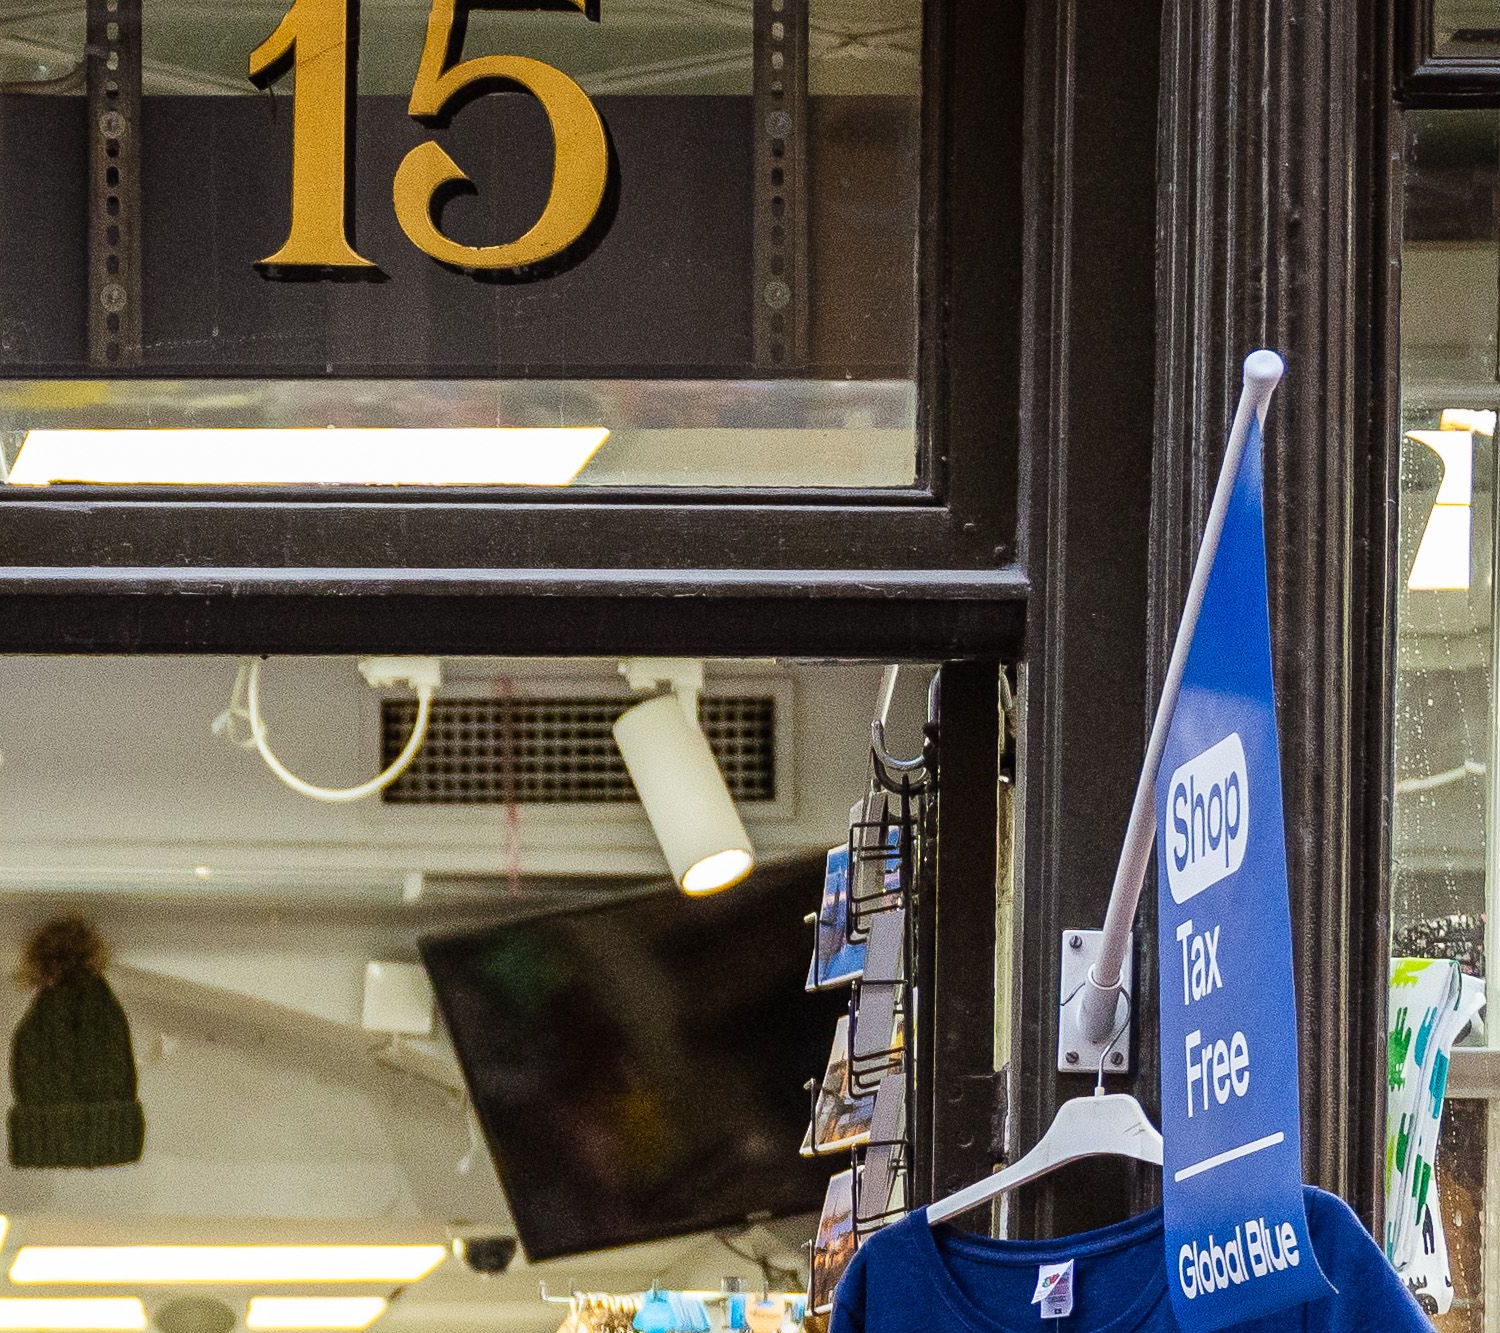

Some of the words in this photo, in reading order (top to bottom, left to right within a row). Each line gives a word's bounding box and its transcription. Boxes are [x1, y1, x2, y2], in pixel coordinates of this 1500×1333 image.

[248, 0, 612, 275] 15
[1172, 769, 1242, 872] Shop
[1176, 918, 1223, 1006] Tax
[1184, 1029, 1250, 1119] Free
[1178, 1225, 1250, 1300] Global
[1244, 1216, 1300, 1278] Blue
